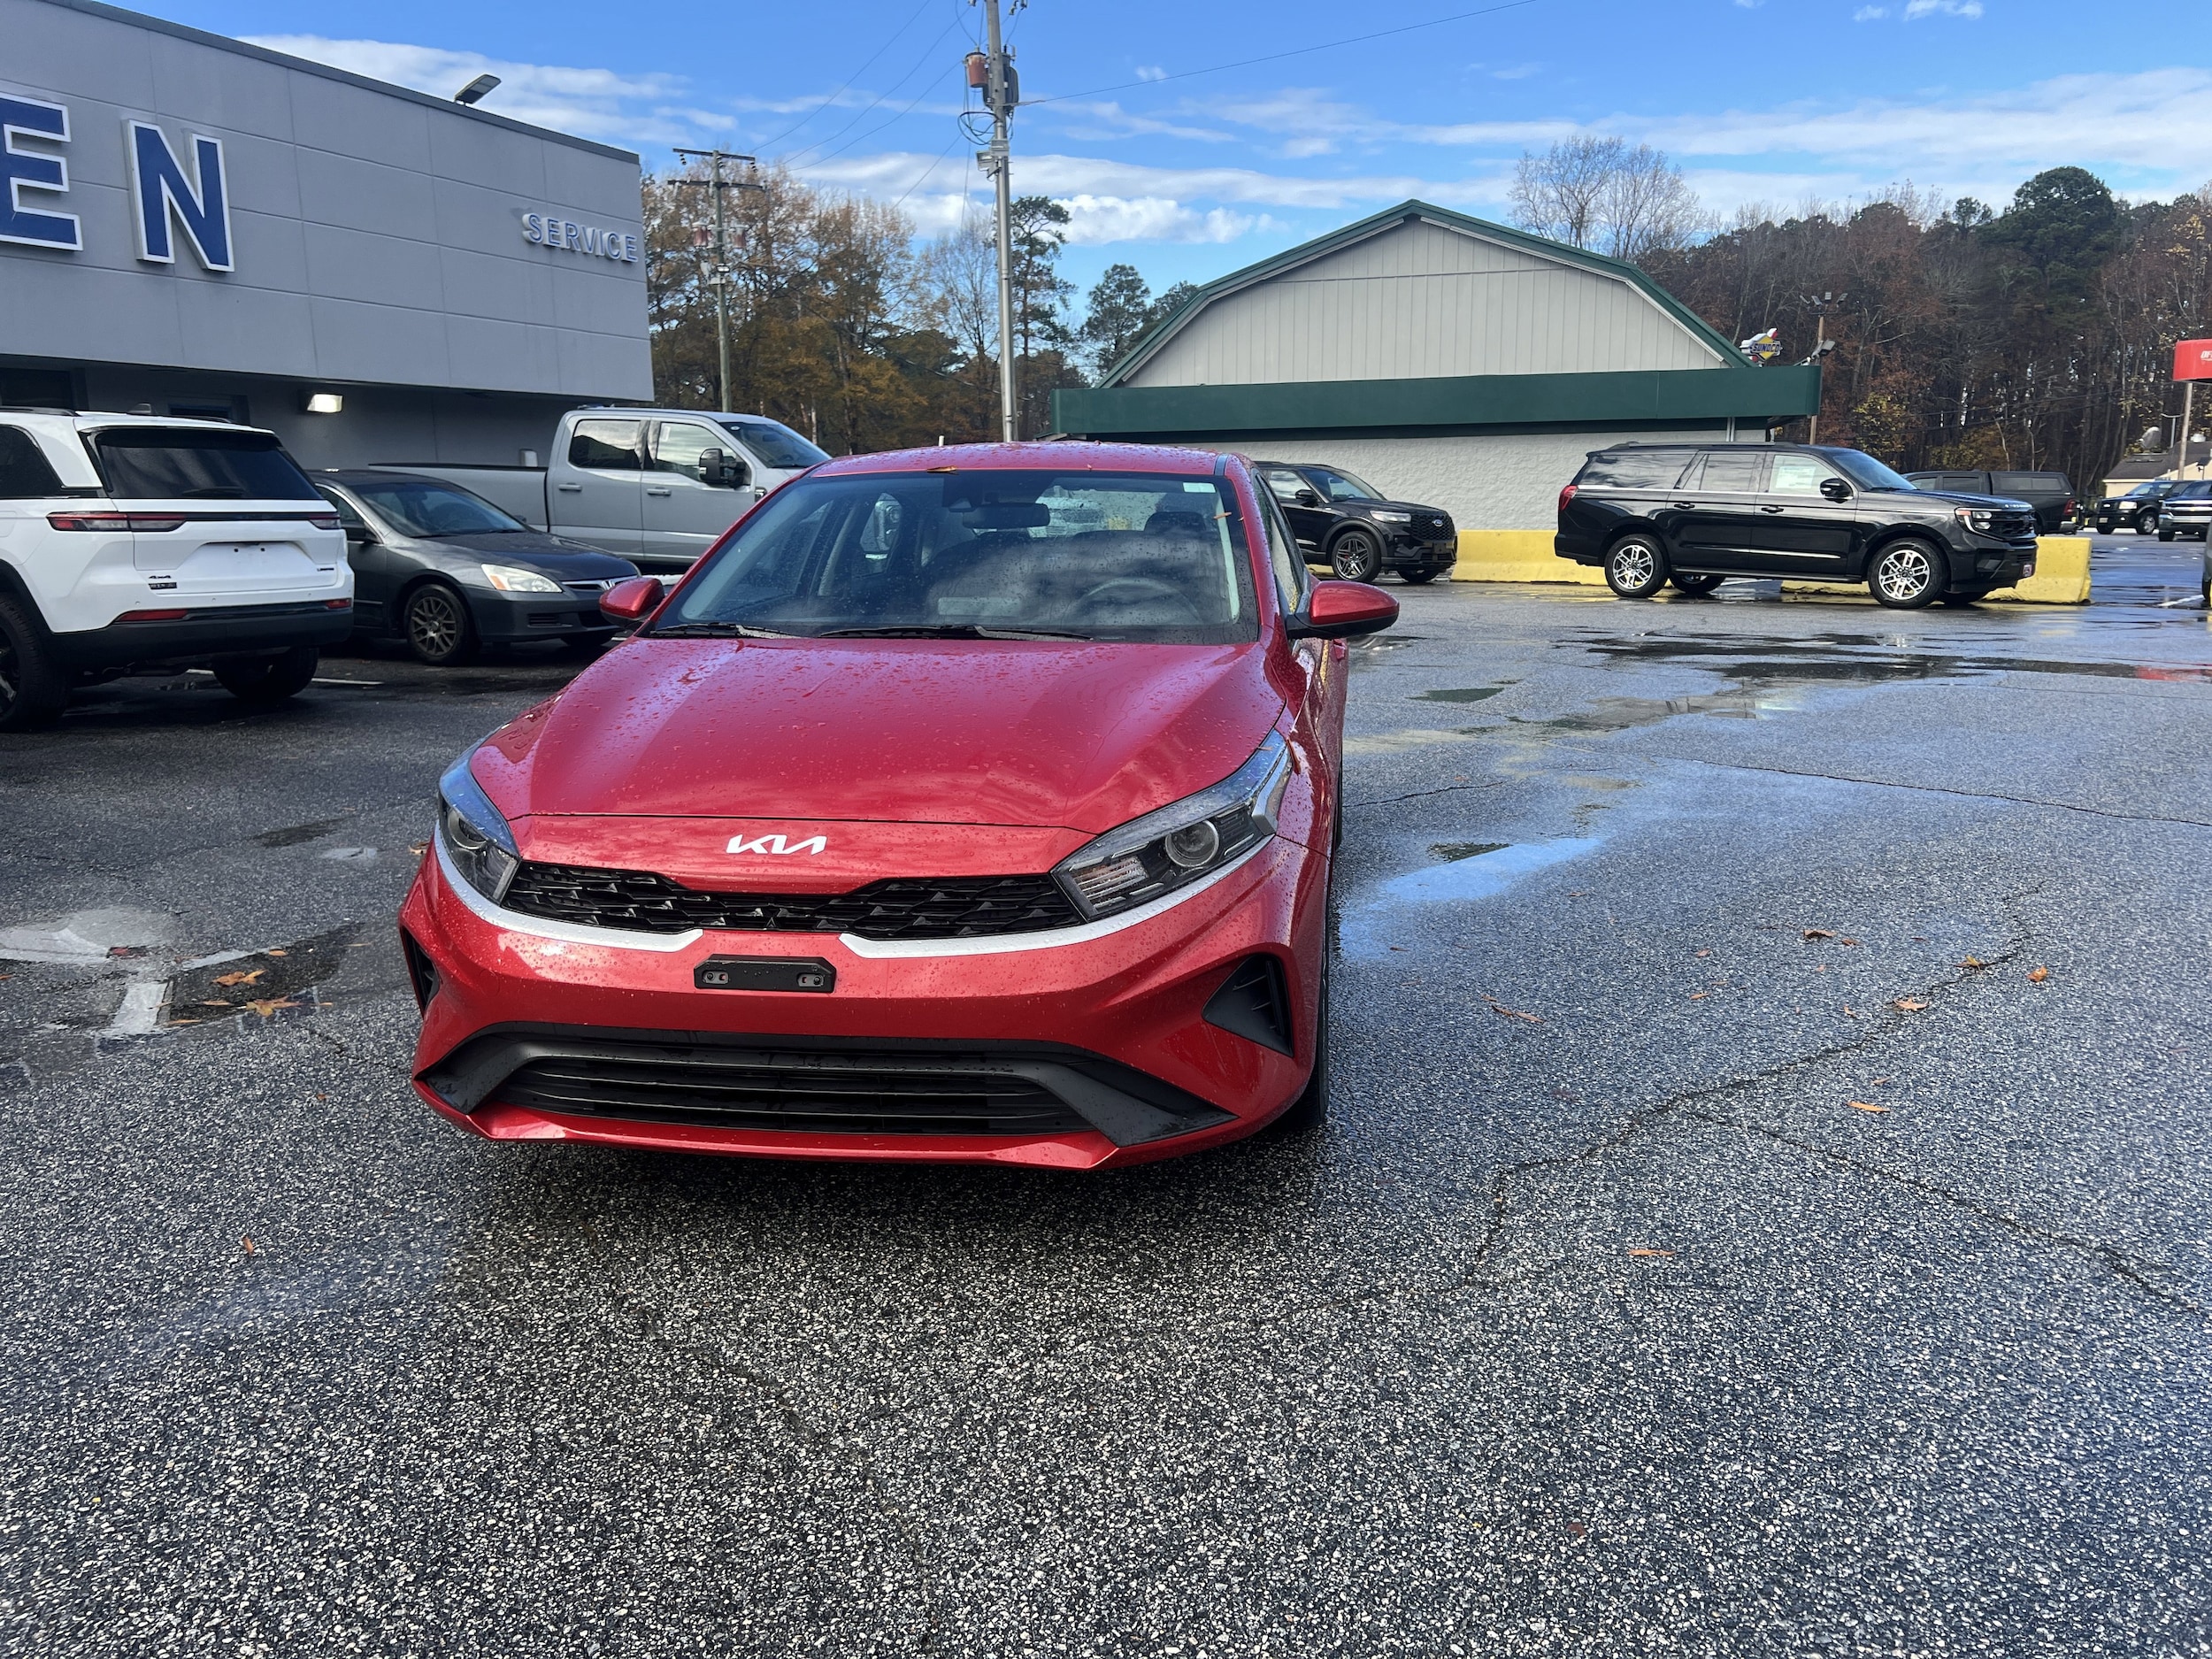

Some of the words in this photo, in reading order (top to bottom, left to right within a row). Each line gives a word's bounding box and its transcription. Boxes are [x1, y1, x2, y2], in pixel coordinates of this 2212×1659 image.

[522, 212, 639, 263] SERVICE
[1752, 342, 1780, 353] SUNOCO
[726, 833, 827, 856] KIA
